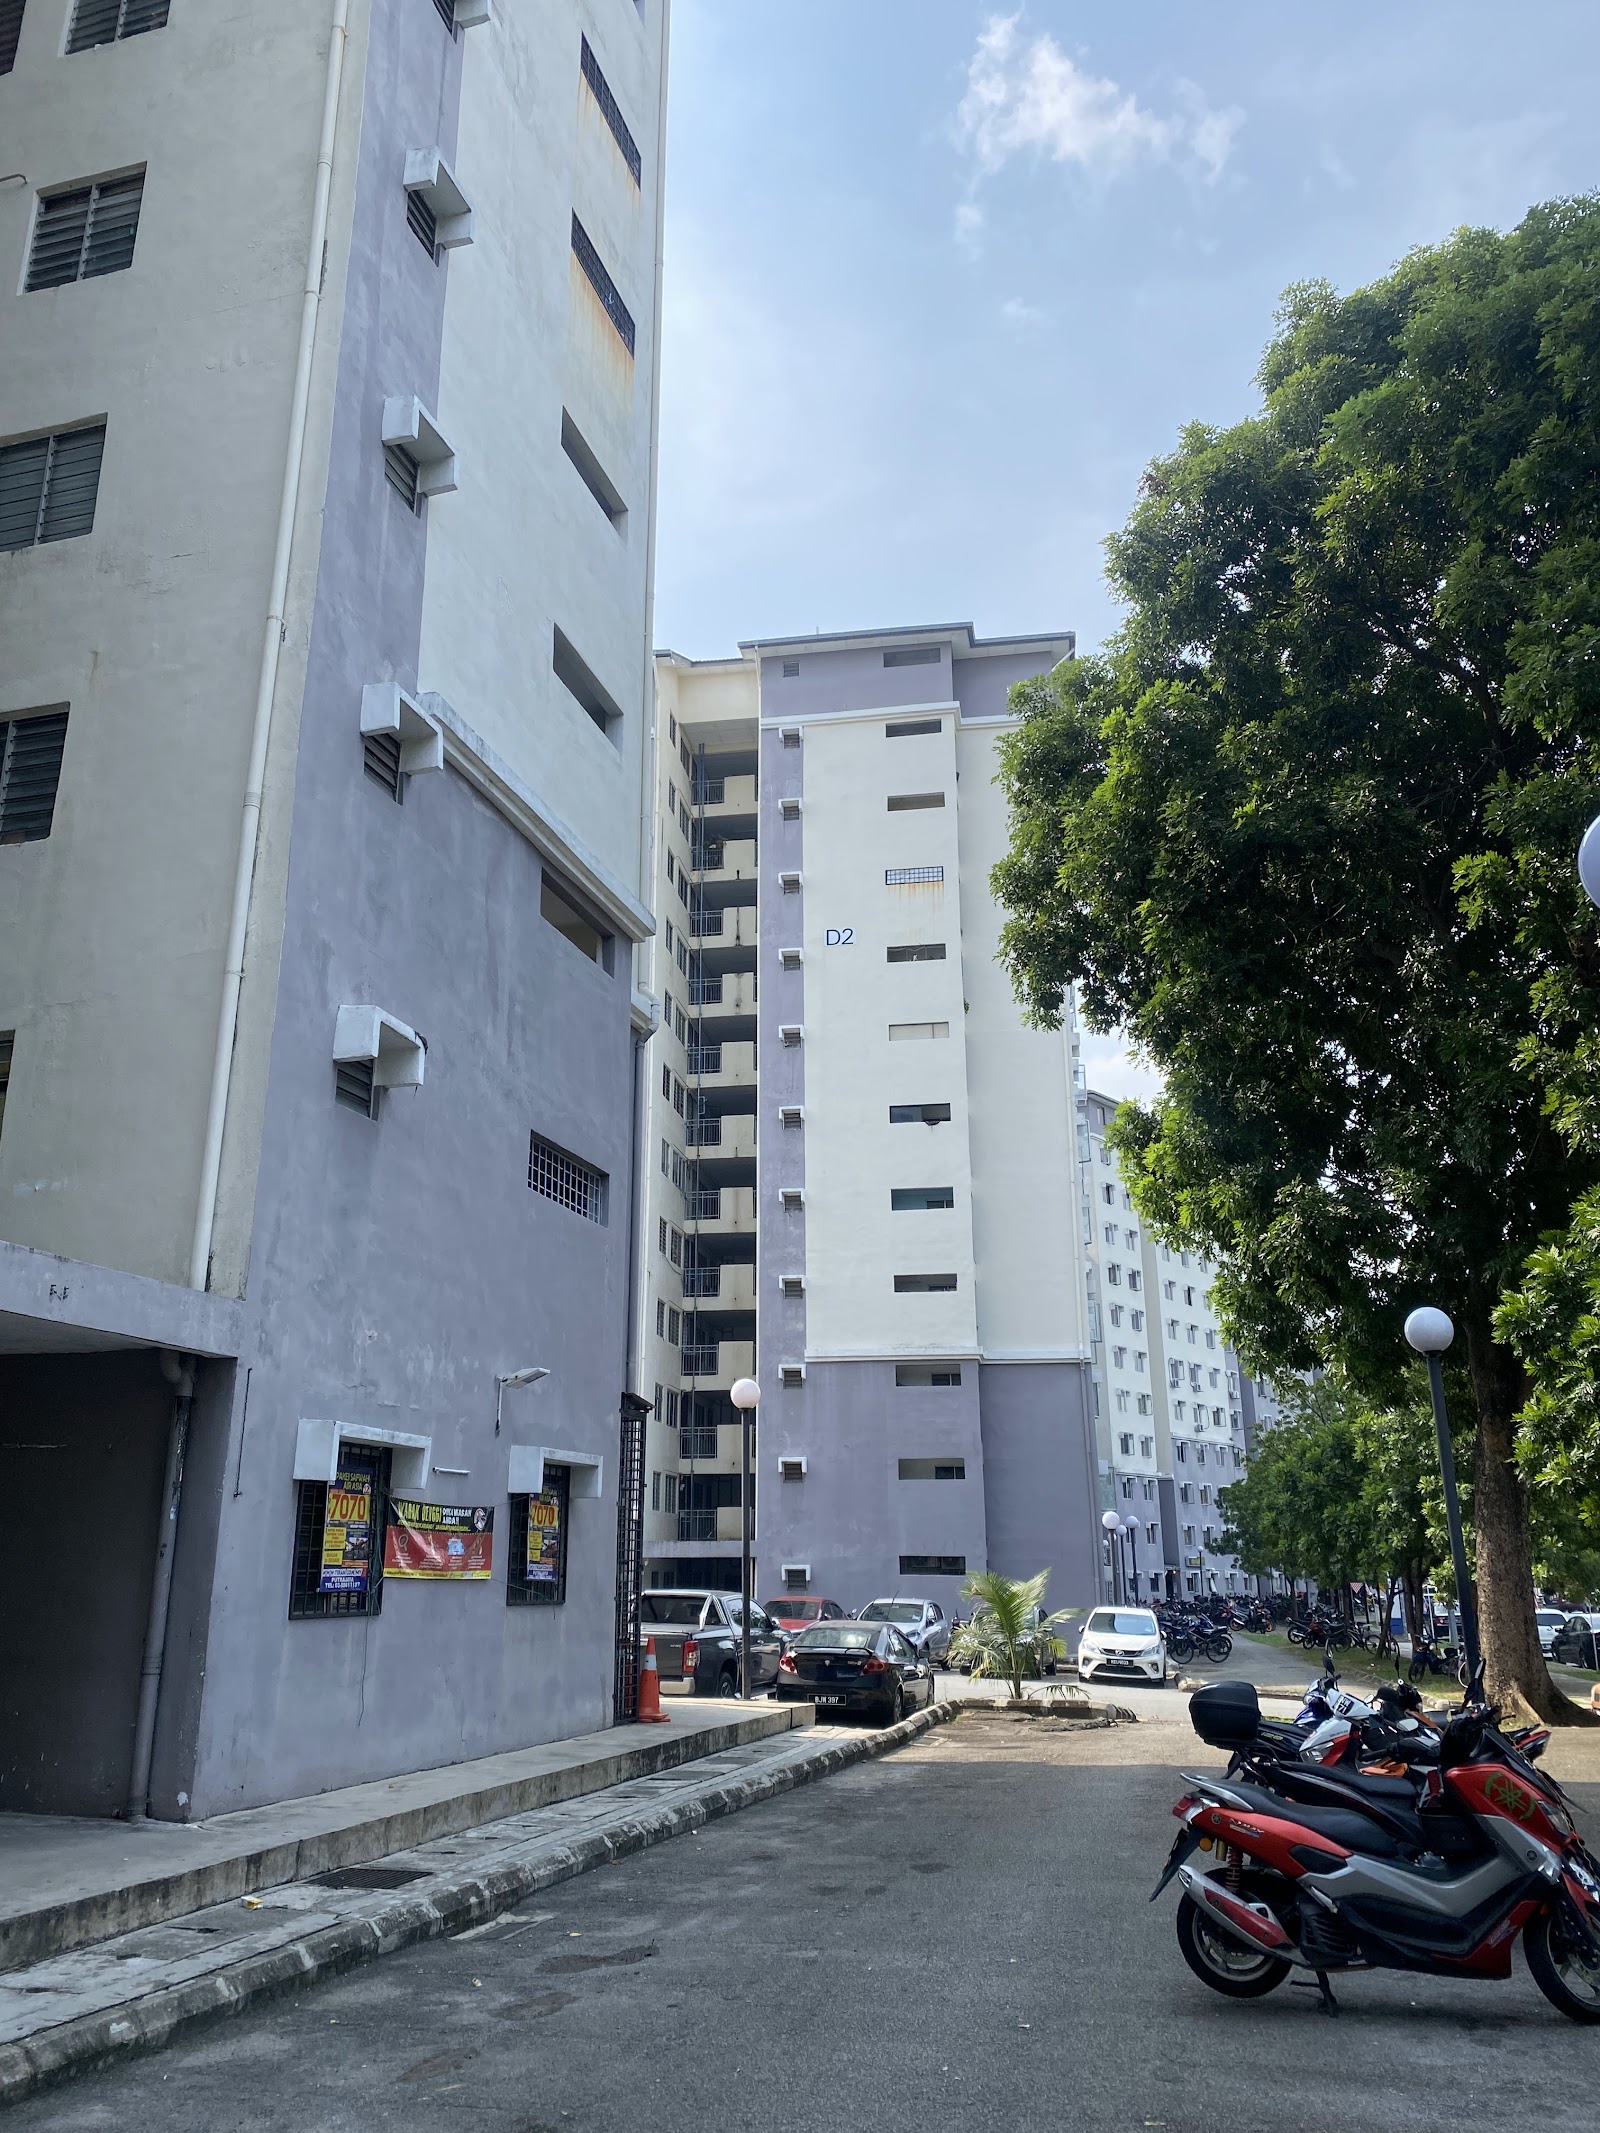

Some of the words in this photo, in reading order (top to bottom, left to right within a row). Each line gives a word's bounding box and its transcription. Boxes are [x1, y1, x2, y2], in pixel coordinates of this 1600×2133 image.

[826, 928, 854, 946] D2
[331, 1493, 366, 1520] 7070
[828, 1696, 839, 1704] 397
